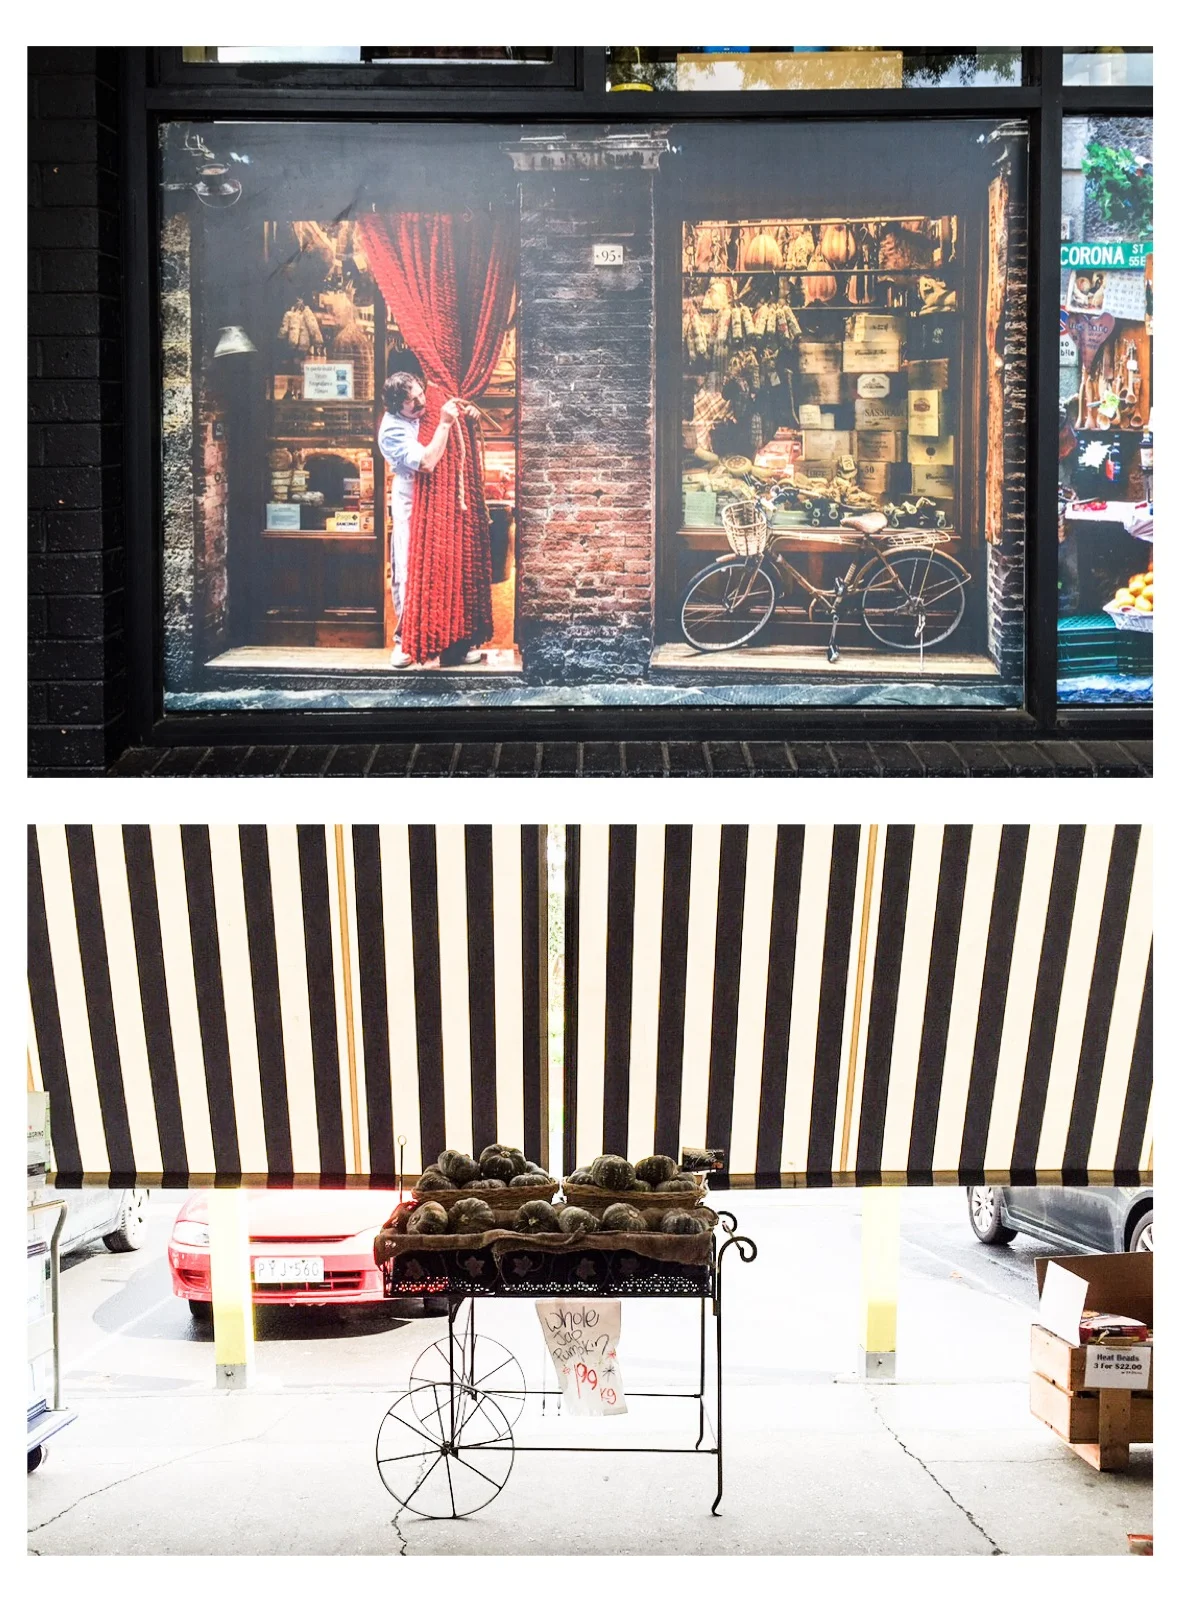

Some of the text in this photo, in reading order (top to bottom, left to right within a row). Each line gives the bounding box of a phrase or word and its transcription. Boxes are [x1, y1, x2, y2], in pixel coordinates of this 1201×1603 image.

[601, 250, 616, 262] 95
[1060, 244, 1144, 266] CORONA ST
[1097, 1353, 1140, 1362] Heat Beads
